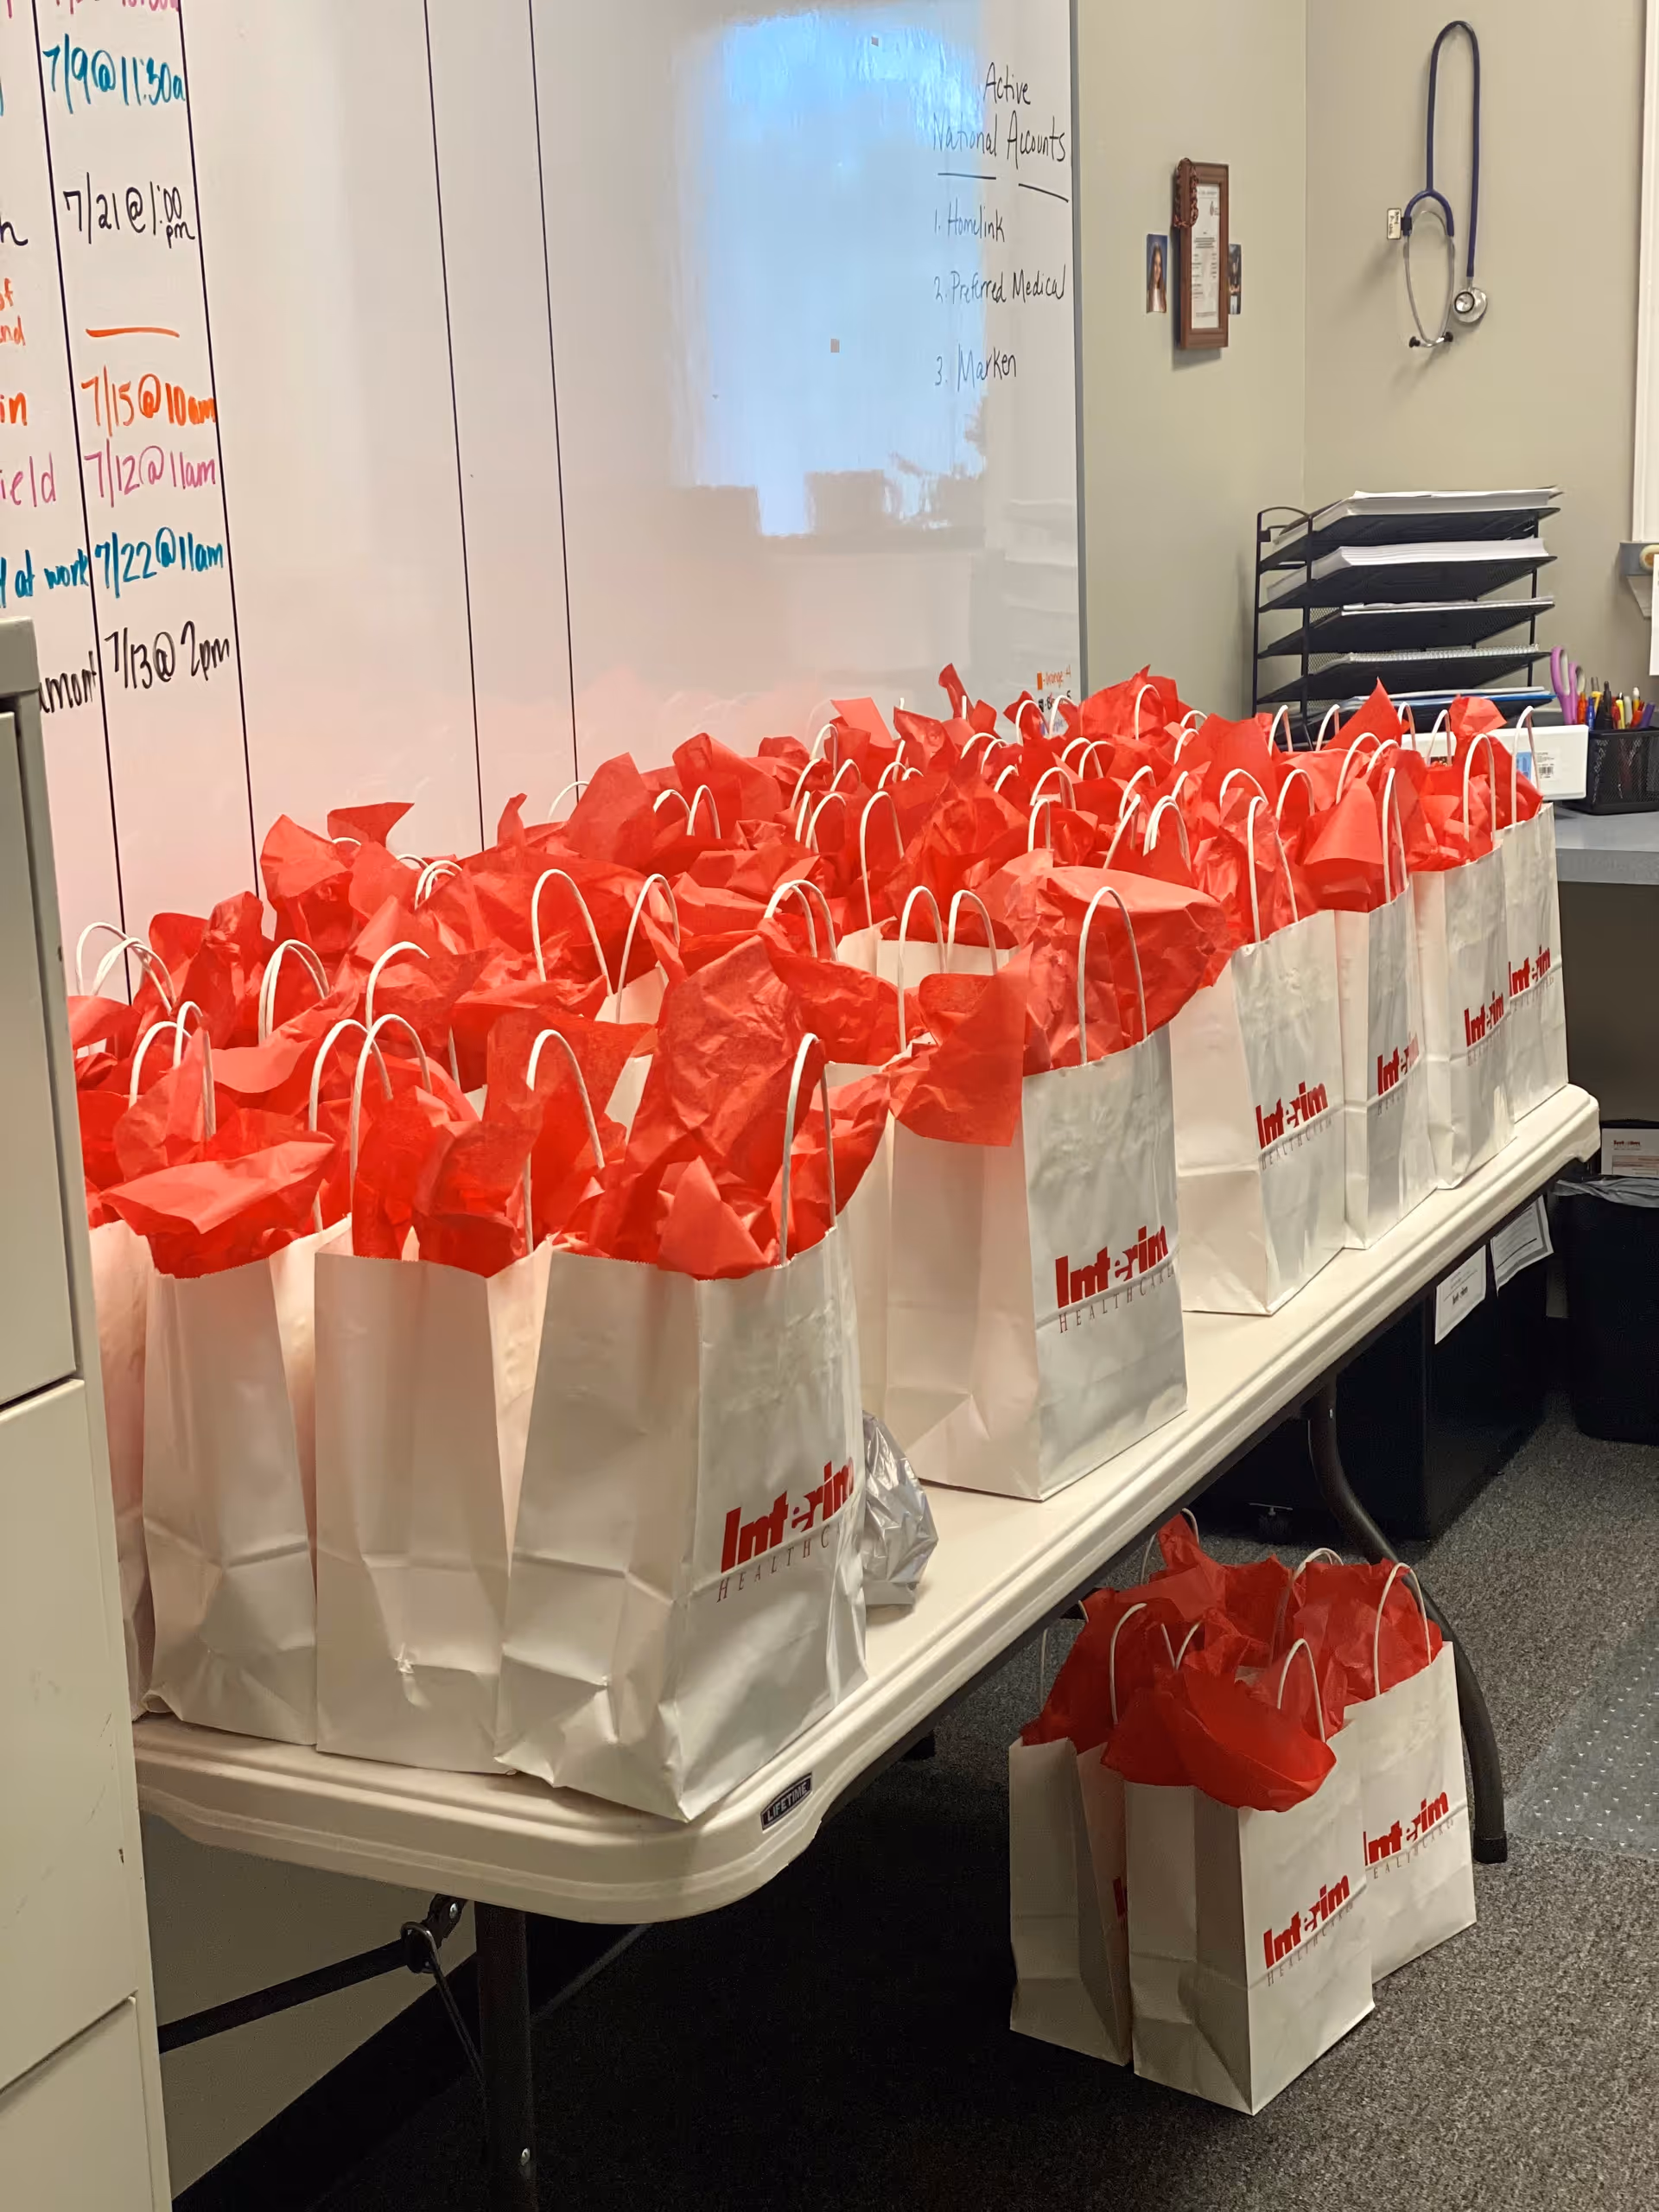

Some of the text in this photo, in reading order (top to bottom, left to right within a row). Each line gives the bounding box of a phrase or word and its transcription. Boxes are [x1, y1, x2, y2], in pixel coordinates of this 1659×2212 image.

[983, 61, 1031, 105] Active
[933, 110, 1066, 169] National Accounts
[947, 197, 1005, 243] Homelink
[950, 270, 1007, 304] Preferred
[1013, 264, 1066, 303] Medical
[957, 343, 1017, 392] Marken
[43, 548, 89, 589] work
[1464, 990, 1503, 1047] Interim
[1255, 1081, 1328, 1149] Interim
[1055, 1225, 1168, 1308] Interim
[721, 1457, 854, 1573] Interim
[766, 1781, 808, 1821] LIFETIME
[1263, 1875, 1350, 1969] Interim
